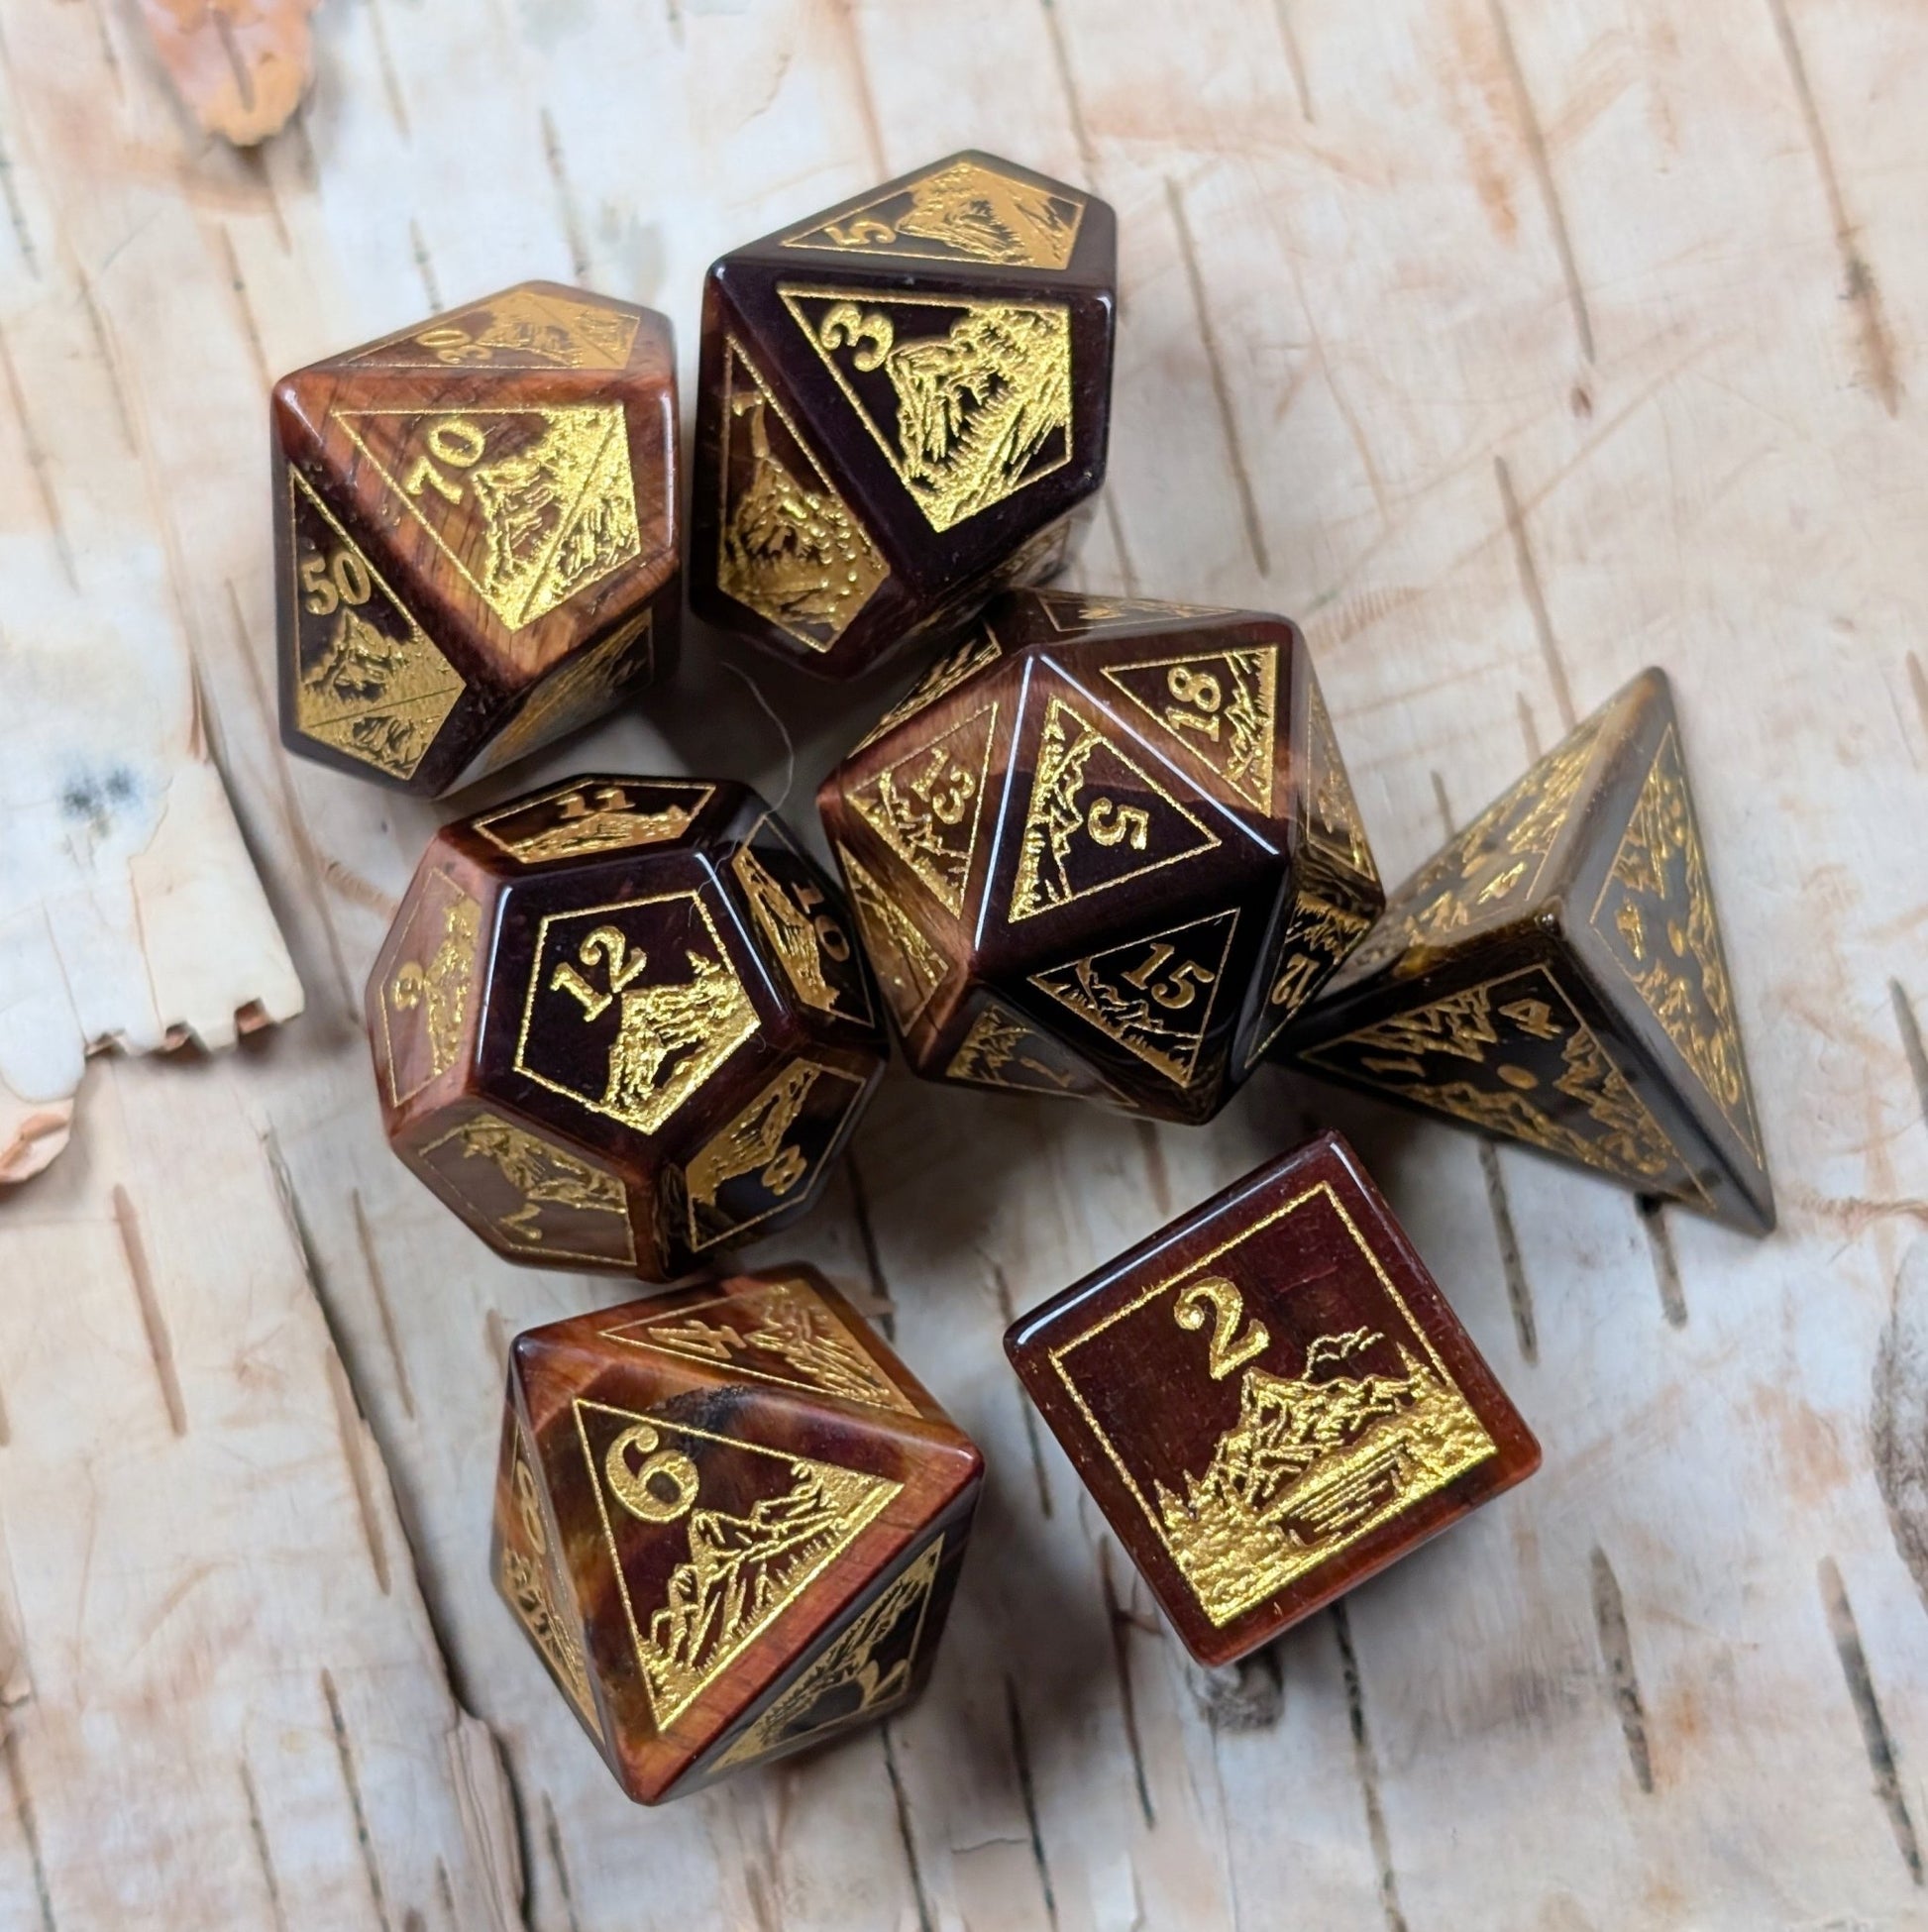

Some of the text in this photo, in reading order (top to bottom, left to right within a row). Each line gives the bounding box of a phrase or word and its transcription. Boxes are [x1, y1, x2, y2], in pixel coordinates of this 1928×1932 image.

[824, 220, 896, 245] 5
[416, 330, 492, 364] 30
[821, 302, 894, 372] 3
[732, 390, 770, 458] 7
[405, 420, 485, 504] 70
[301, 551, 371, 615] 50
[1165, 666, 1221, 743] 18
[556, 788, 636, 819] 11
[910, 744, 976, 824] 13
[1087, 797, 1149, 850] 5
[791, 880, 850, 962] 10
[550, 925, 648, 1022] 12
[1120, 942, 1216, 1010] 15
[1499, 998, 1564, 1040] 4
[760, 1143, 807, 1196] 8
[647, 1319, 747, 1359] 4
[1173, 1276, 1270, 1380] 2
[516, 1458, 547, 1556] 8
[605, 1424, 699, 1523] 6
